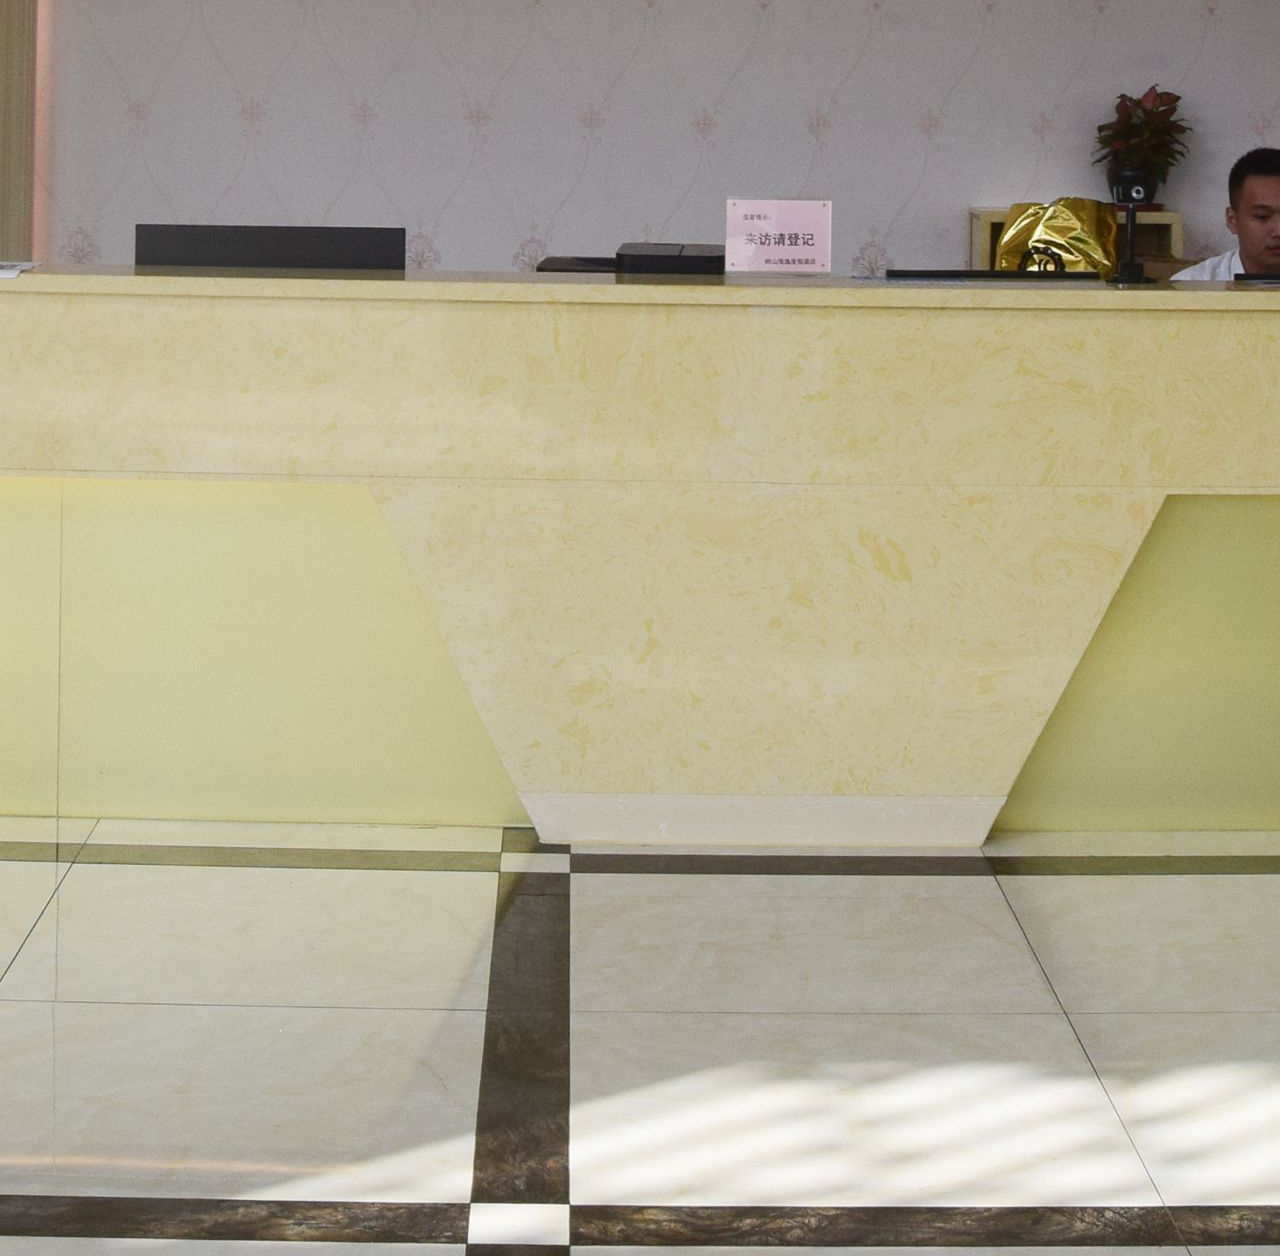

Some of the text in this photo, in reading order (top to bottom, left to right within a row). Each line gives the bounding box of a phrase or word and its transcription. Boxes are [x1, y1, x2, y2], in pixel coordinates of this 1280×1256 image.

[744, 232, 815, 247] 来访请登记
